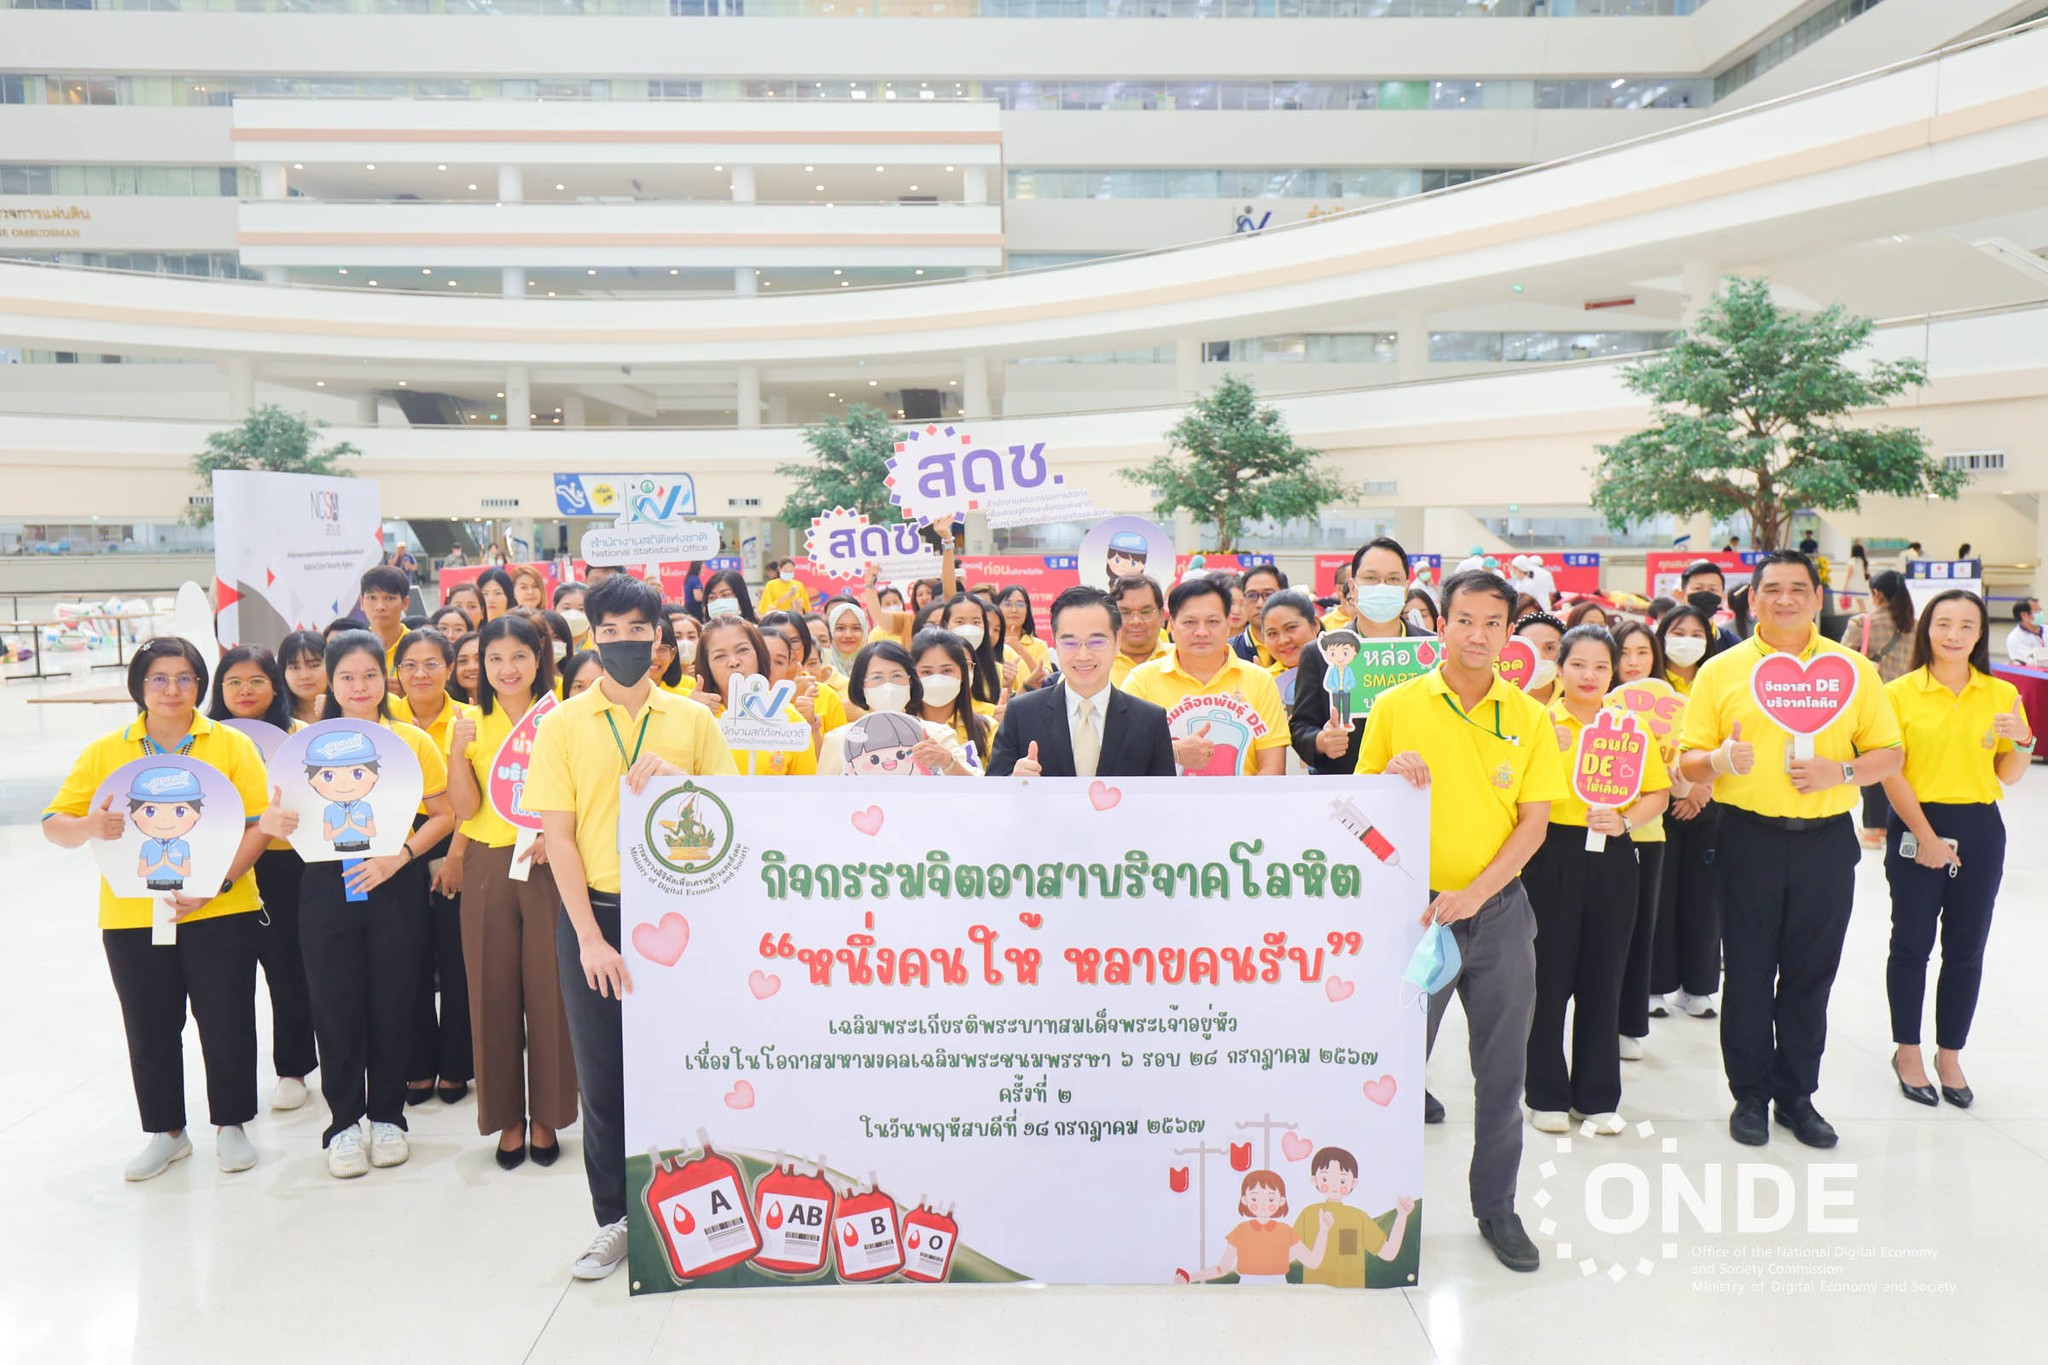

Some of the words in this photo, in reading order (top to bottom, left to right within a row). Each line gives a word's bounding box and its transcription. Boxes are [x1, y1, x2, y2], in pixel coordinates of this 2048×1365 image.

[917, 442, 1064, 498] สดช.
[590, 532, 708, 548] สำนักงานสถิติแห่งชาติ
[591, 547, 631, 558] National
[633, 546, 680, 556] Statistical
[682, 543, 709, 552] Office
[829, 523, 931, 559] สดช.
[1363, 643, 1411, 667] หล่อ
[1765, 681, 1812, 692] จิตอาสา
[1816, 679, 1840, 692] DE
[1624, 689, 1684, 720] DE
[1766, 696, 1838, 708] บริจาคโลหิต
[1246, 713, 1268, 737] DE
[1581, 751, 1616, 778] DE
[1586, 778, 1629, 796] ให้เลือด
[629, 845, 648, 878] Ministry
[648, 876, 656, 885] of
[657, 881, 683, 896] Digital
[686, 882, 721, 896] Economy
[722, 873, 736, 885] and
[733, 845, 750, 872] Society
[761, 840, 1362, 900] กิจกรรมจิตอาสาบริจาคโลหิต
[759, 911, 1042, 988] “หนึ่งคนให้
[1063, 931, 1363, 986] หลายคนรับ”
[828, 1004, 1238, 1041] เฉลิมพระเกียรติพระบาทสมเด็จพระเจ้าอยู่หัว
[685, 1041, 1111, 1071] เนื่องในโอกาสมหามงคลเฉลิมพระชนมพรรษา
[1120, 1050, 1133, 1068] ๖
[1143, 1051, 1181, 1067] รอบ
[1190, 1049, 1218, 1066] ๒๘
[1227, 1048, 1311, 1071] กรกฎาคม
[1318, 1046, 1379, 1066] ๒๕๖๗
[999, 1074, 1048, 1103] ครั้งที่
[1058, 1087, 1072, 1104] ๒
[858, 1108, 1018, 1143] ในวันพฤหัสบดีที่
[1023, 1120, 1050, 1138] ๑๘
[1054, 1118, 1139, 1143] กรกฎาคม
[1146, 1116, 1206, 1135] ๒๕๖๗
[710, 1189, 732, 1215] A
[787, 1203, 823, 1227] AB
[870, 1216, 887, 1236] B
[928, 1235, 943, 1250] O
